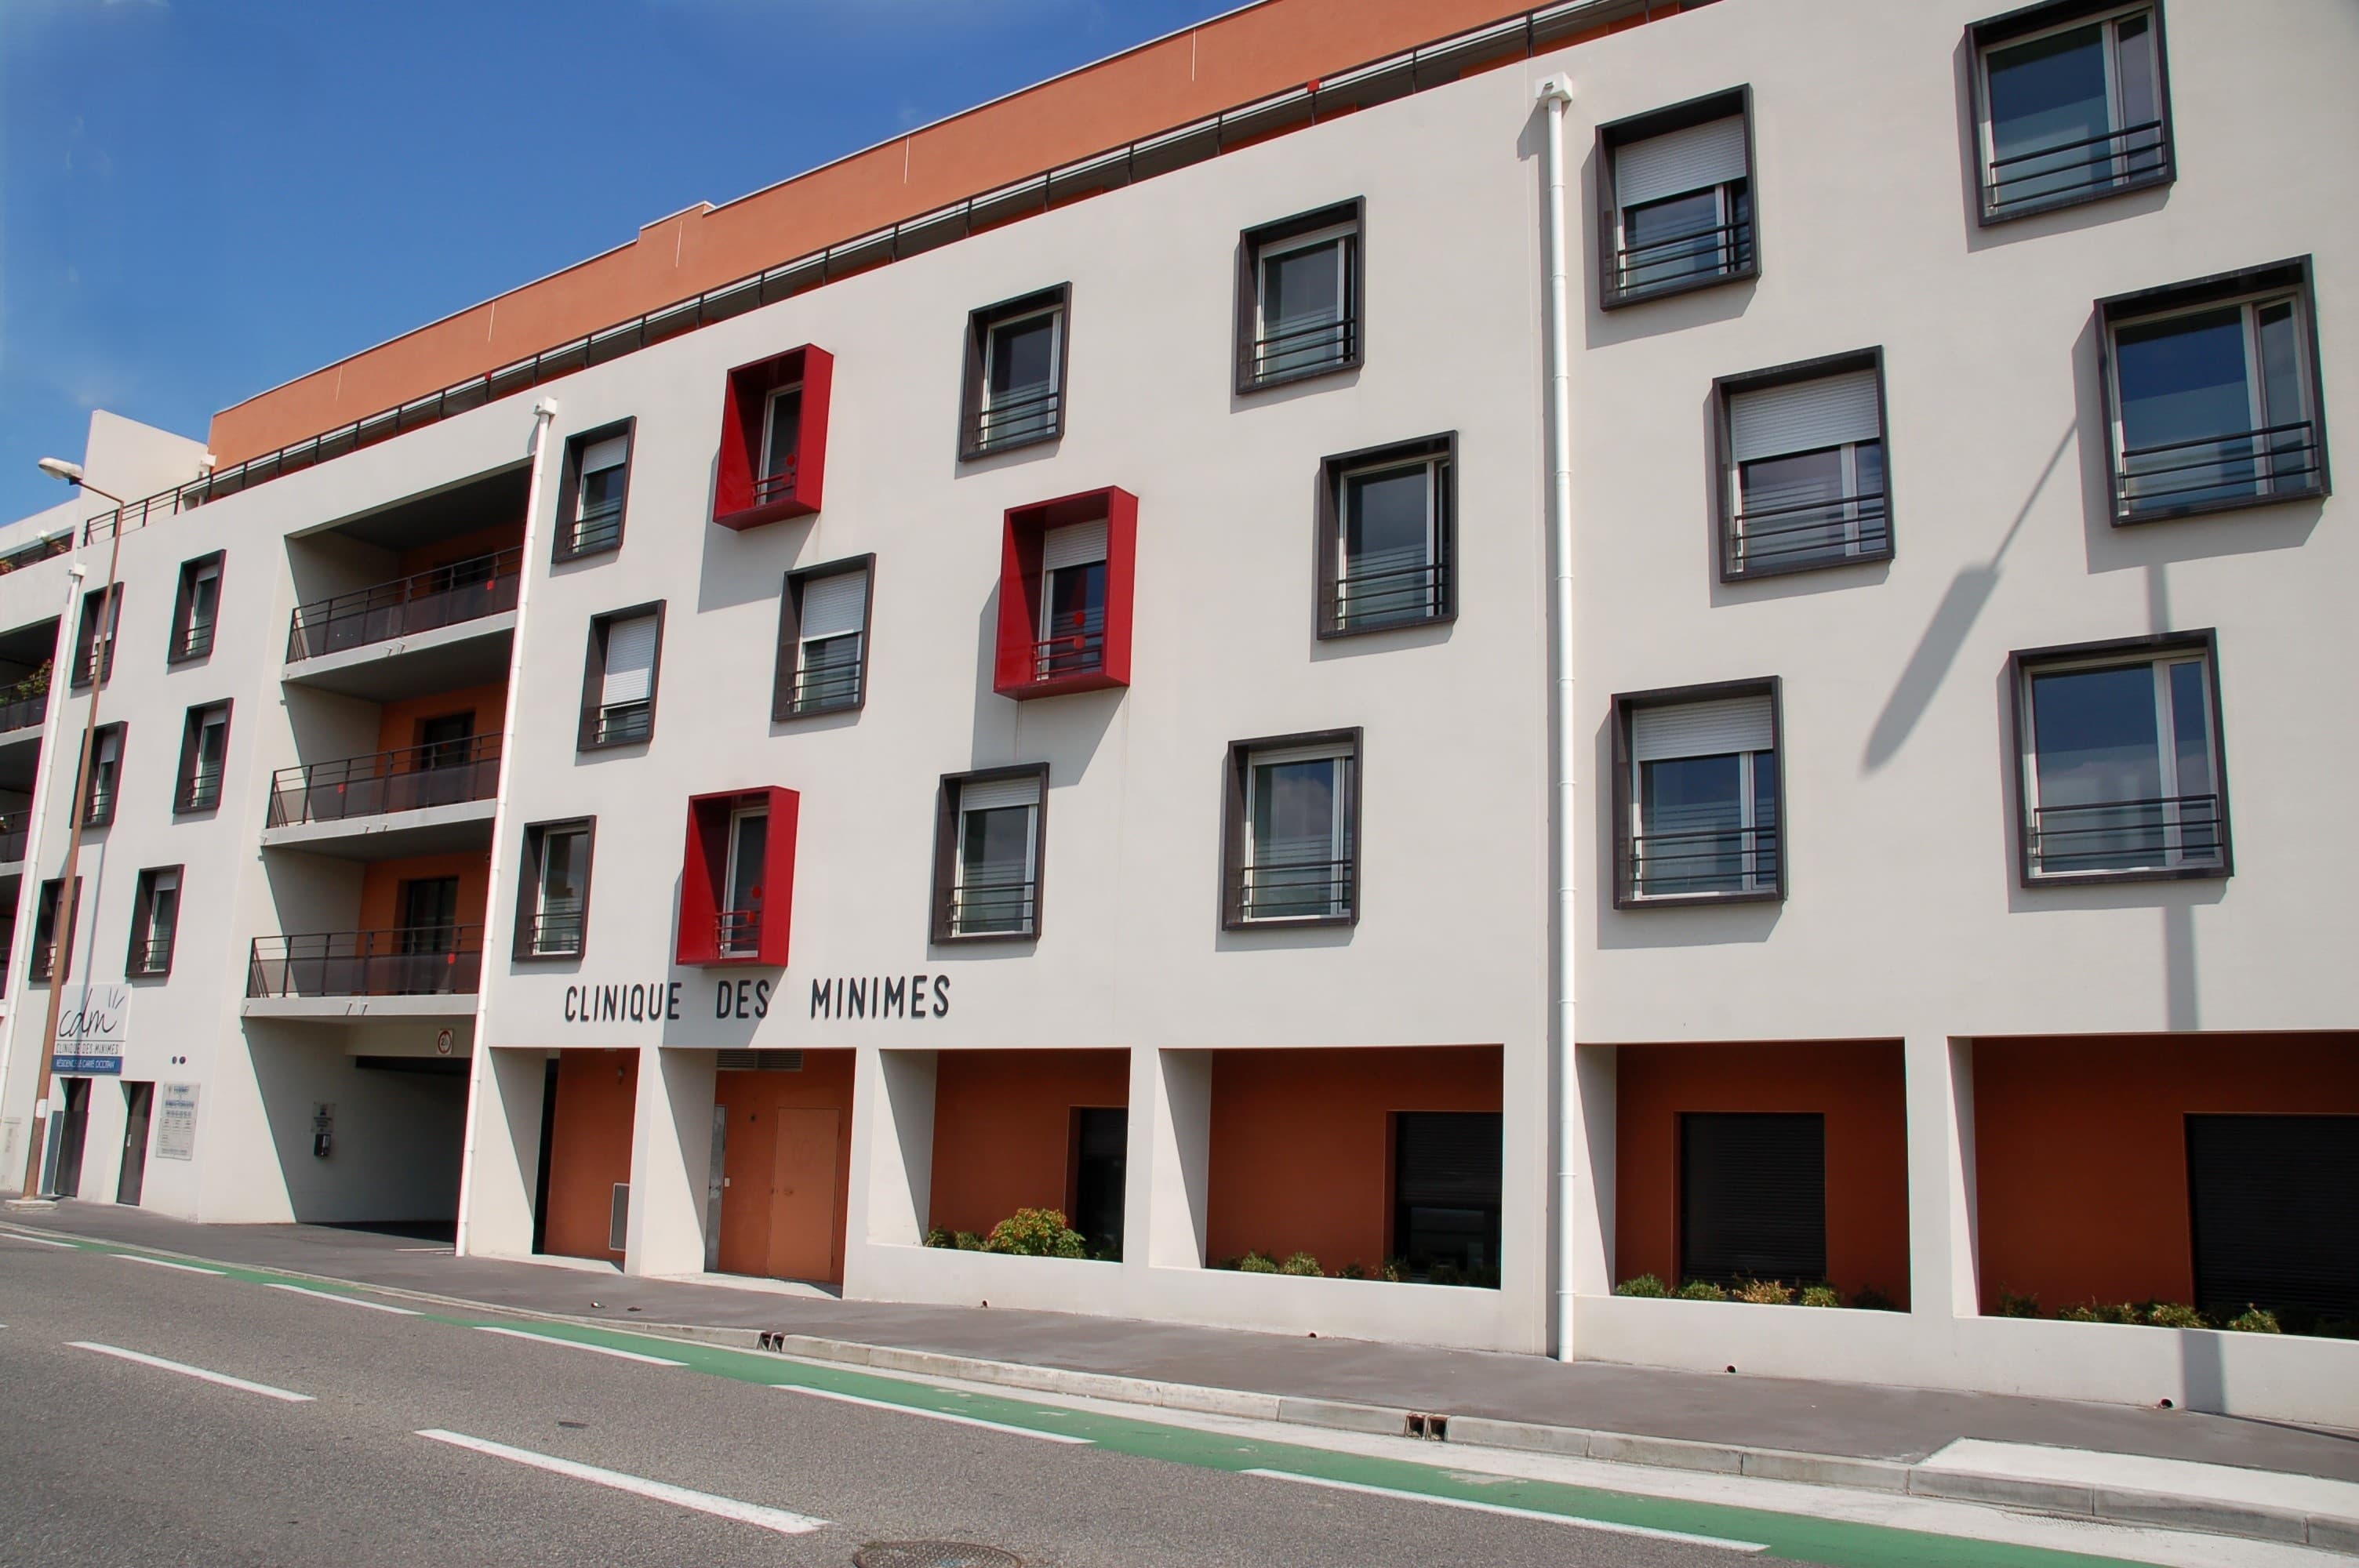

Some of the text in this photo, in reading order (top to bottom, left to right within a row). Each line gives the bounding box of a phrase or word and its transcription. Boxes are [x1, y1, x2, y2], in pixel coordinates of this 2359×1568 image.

[565, 975, 951, 1022] CLINIQUE DES MINIMES
[56, 1043, 119, 1054] CLINIQUE DES MINIMES
